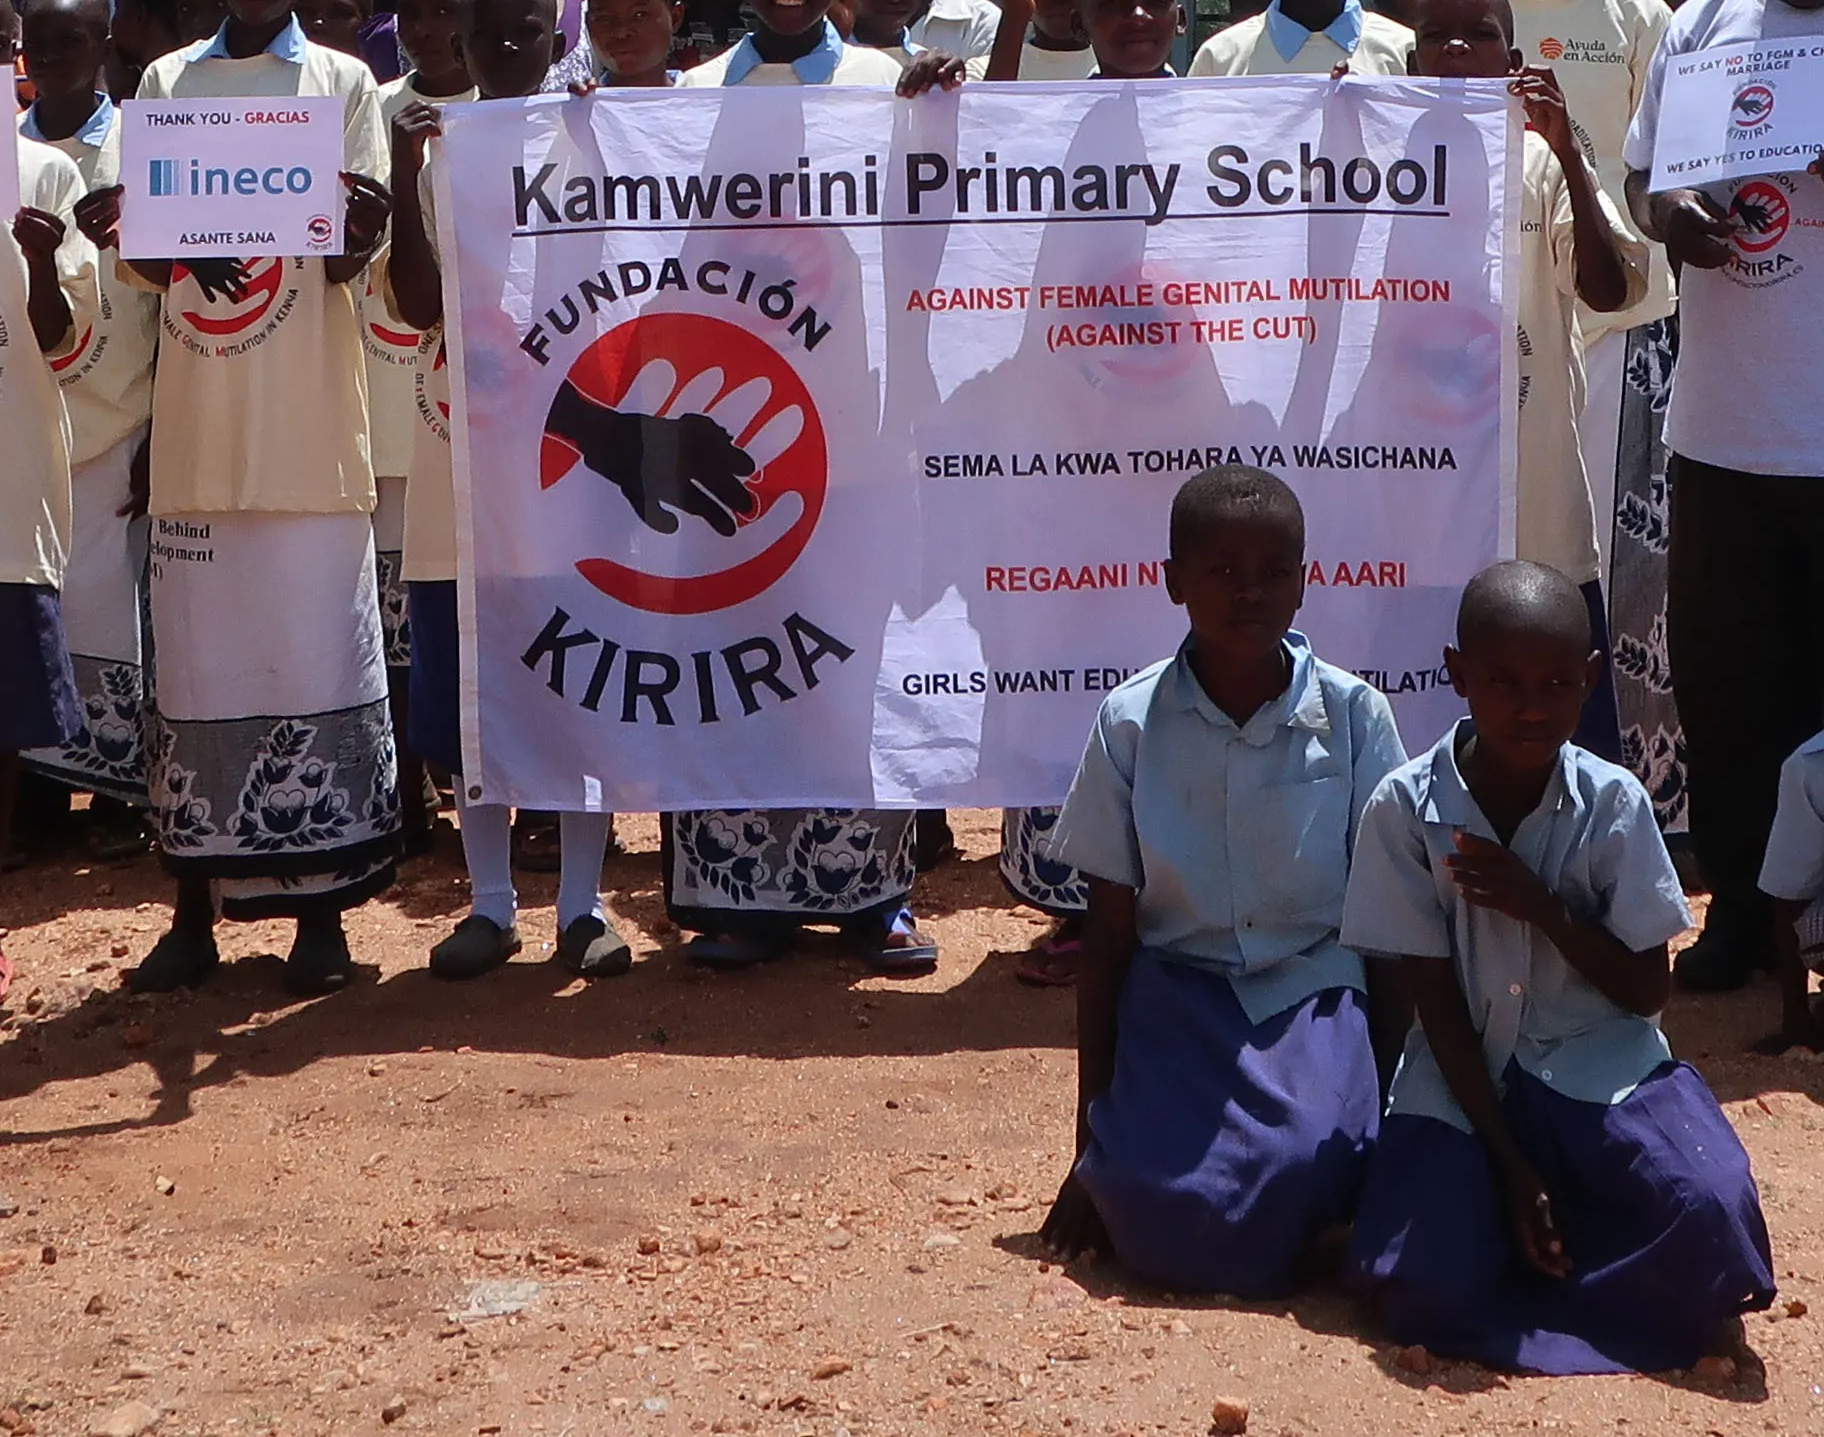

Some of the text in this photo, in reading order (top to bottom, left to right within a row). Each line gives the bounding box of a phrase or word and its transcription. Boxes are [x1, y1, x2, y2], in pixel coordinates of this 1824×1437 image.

[1563, 51, 1626, 64] en Acción
[1565, 38, 1606, 51] Ayuda
[1679, 66, 1695, 76] WE
[1699, 59, 1722, 71] SAY
[1725, 55, 1743, 66] NO
[1748, 52, 1763, 62] TO
[1767, 49, 1794, 61] FGM
[1797, 48, 1807, 58] &
[1726, 60, 1791, 77] MARRIAGE
[146, 114, 196, 126] THANK
[200, 113, 231, 124] YOU
[244, 111, 310, 124] GRACIAS
[1666, 163, 1684, 174] WE
[1687, 158, 1712, 171] SAY
[1715, 152, 1736, 165] YES
[1740, 150, 1755, 161] TO
[190, 159, 313, 196] ineco
[512, 142, 1447, 226] Kamwerini Primary School
[179, 232, 275, 245] ASANTE SANA
[1735, 254, 1794, 276] RIRA
[274, 288, 299, 323] KENYA
[906, 278, 1451, 311] AGAINST FEMALE GENITAL MUTILATION
[519, 257, 832, 366] FUNDACIÓN
[1046, 316, 1318, 353] (AGAINST THE CUT)
[924, 445, 1457, 478] SEMA LA KWA TOHARA YA WASICHANA
[159, 518, 210, 539] Behind
[150, 540, 214, 562] elopment
[985, 562, 1127, 591] REGAANI
[1332, 561, 1406, 588] AARI
[520, 605, 855, 726] KIRIRA
[902, 671, 986, 695] GIRLS
[994, 669, 1075, 693] WANT
